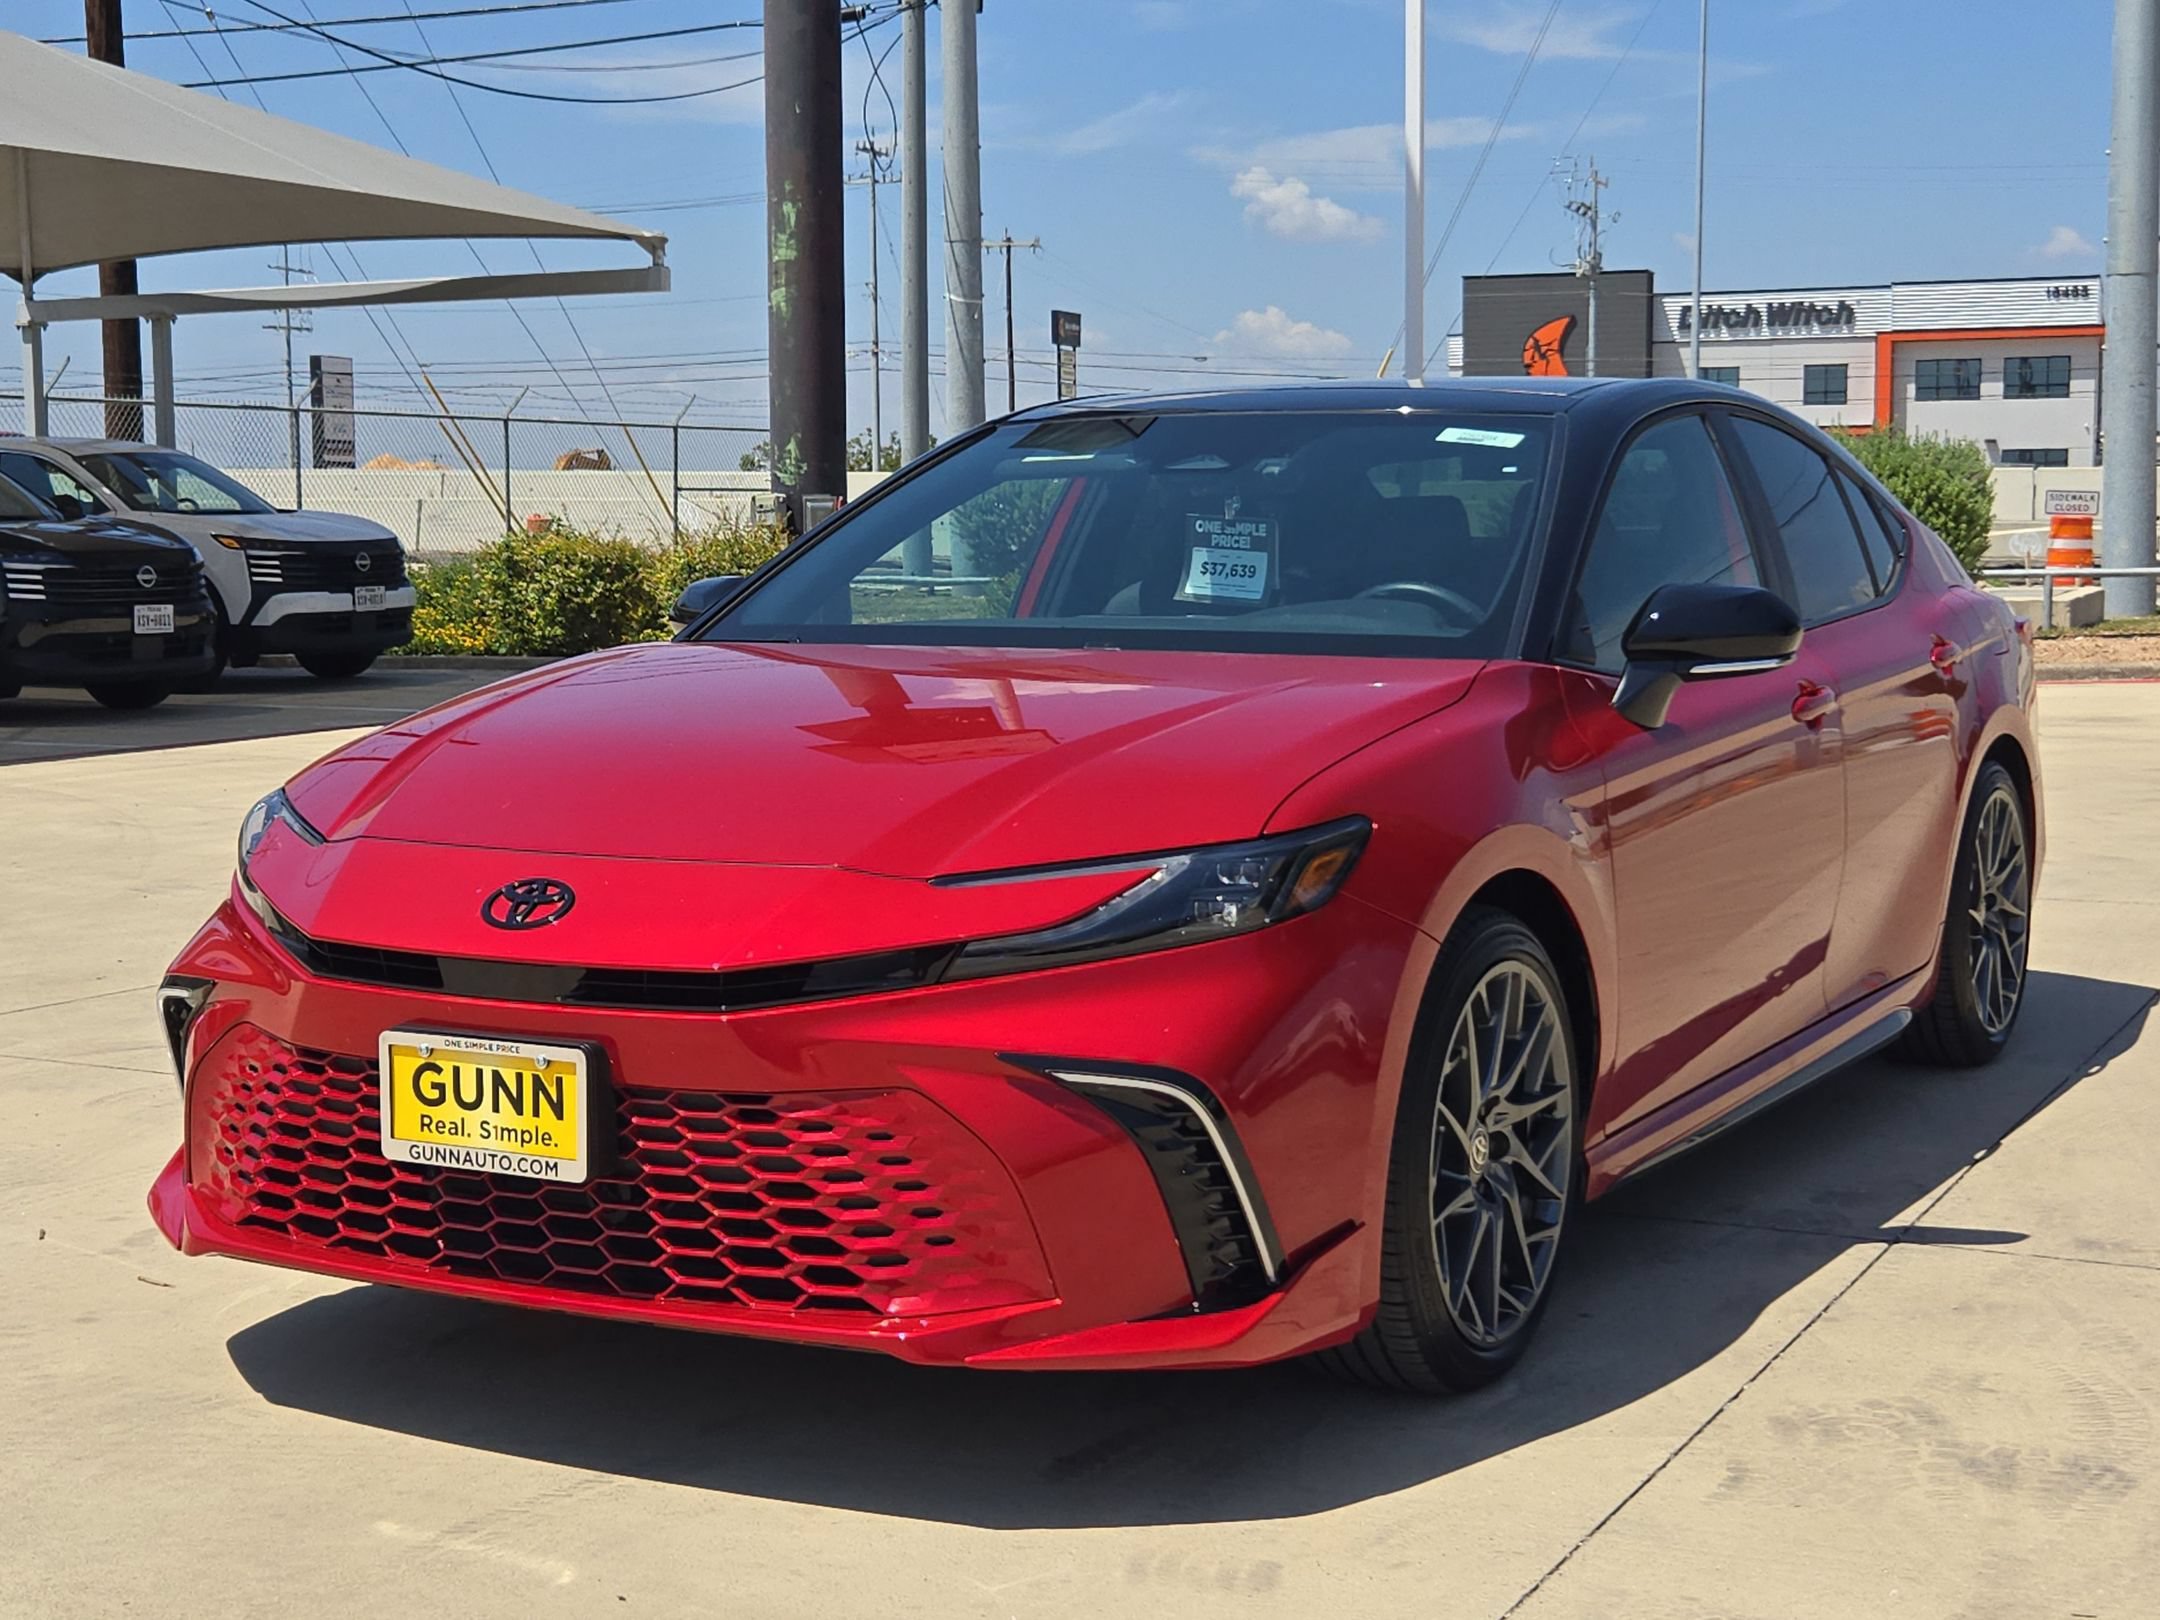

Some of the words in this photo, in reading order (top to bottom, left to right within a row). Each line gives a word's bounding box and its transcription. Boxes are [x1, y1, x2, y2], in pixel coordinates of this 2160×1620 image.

[1766, 301, 1856, 327] Witch
[2049, 493, 2096, 502] SIDEWALK
[2054, 503, 2090, 512] CLOSED
[1195, 519, 1222, 533] ONE
[1200, 561, 1257, 580] $37,639
[444, 1039, 462, 1049] ONE
[464, 1040, 494, 1052] SIMPLE
[495, 1043, 521, 1054] PRICE
[412, 1061, 565, 1121] GUNN
[420, 1114, 472, 1138] Real.
[409, 1144, 559, 1178] GUNNAUTO.COM
